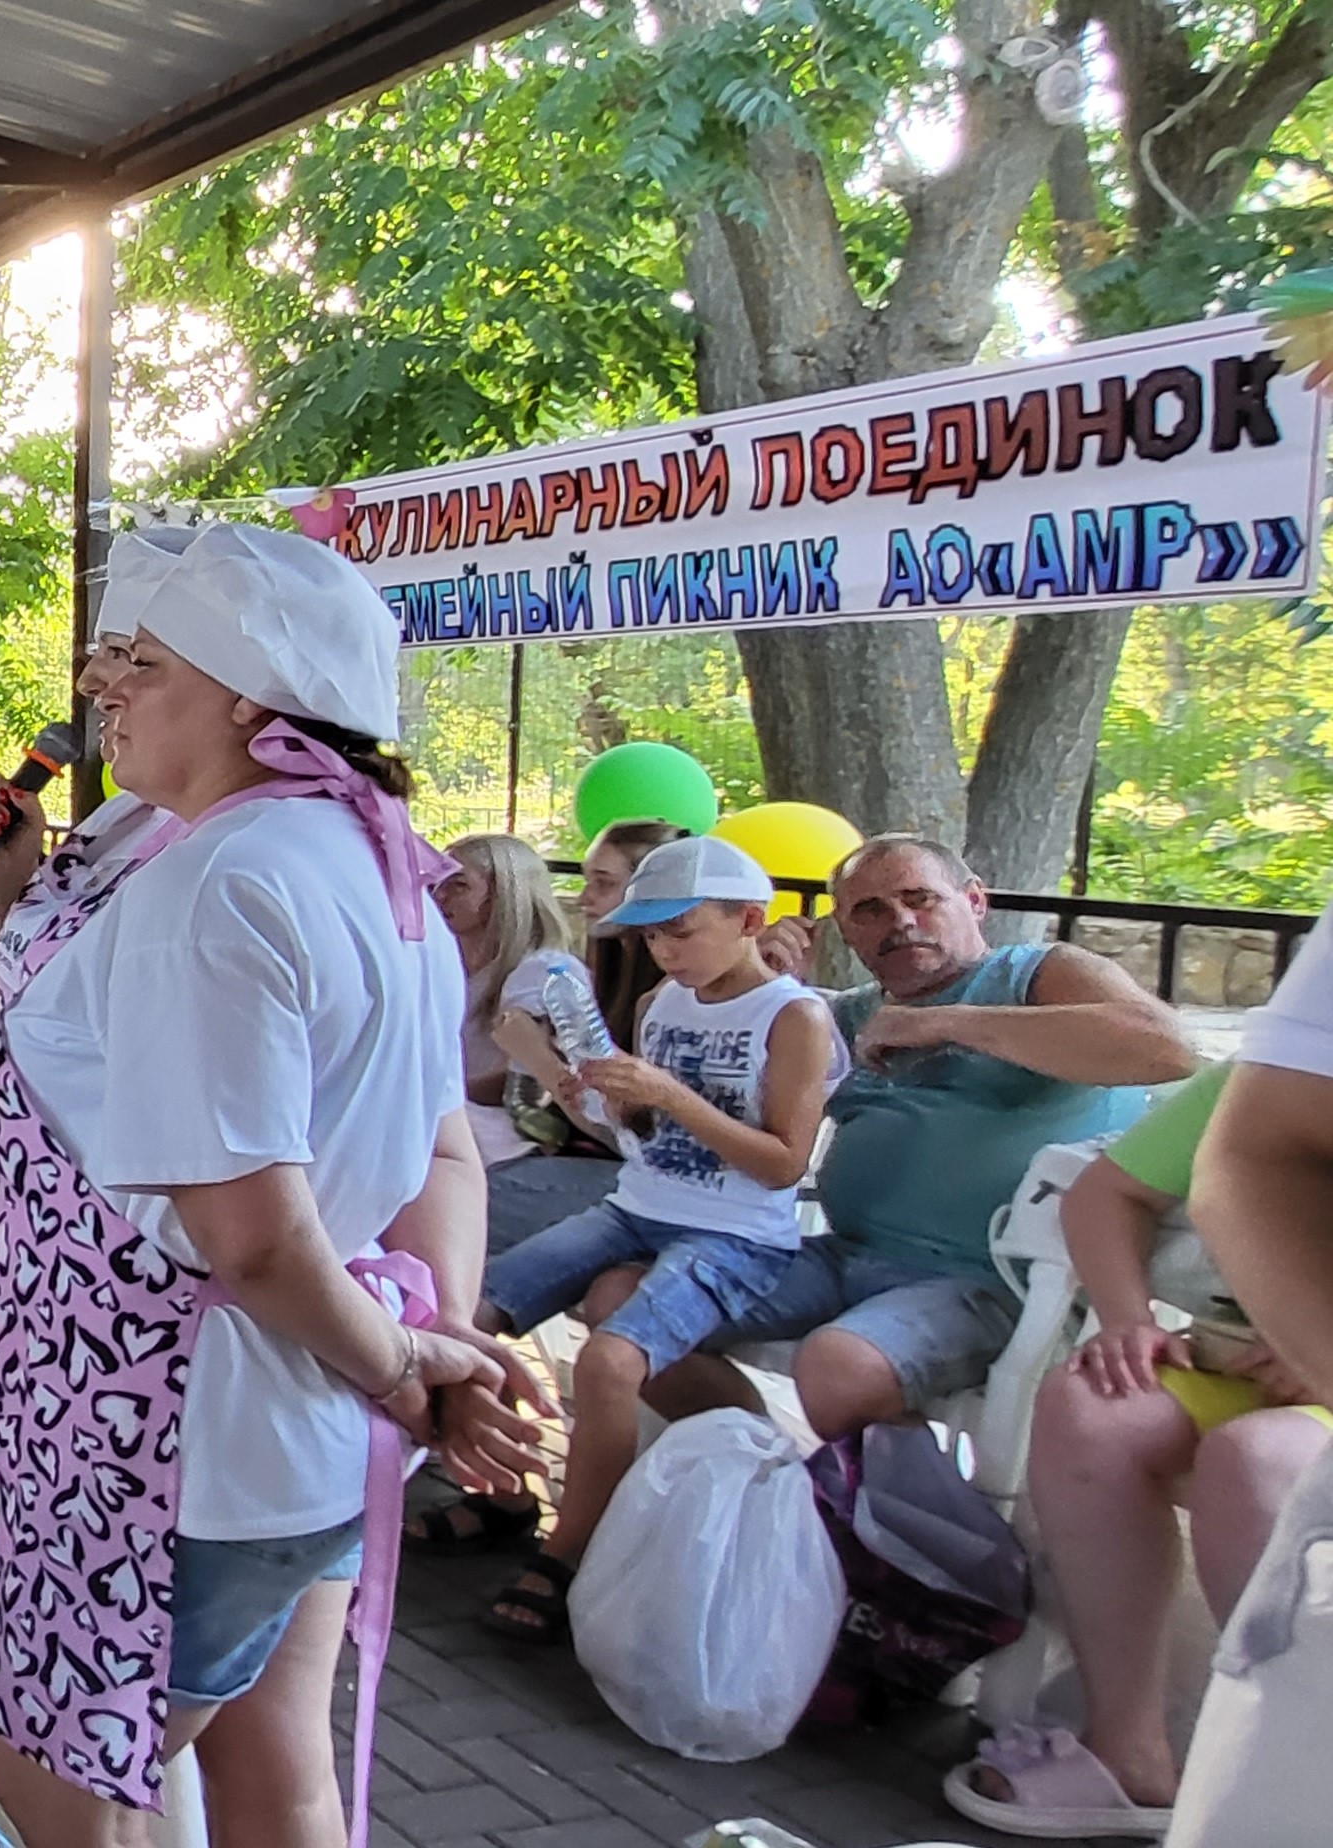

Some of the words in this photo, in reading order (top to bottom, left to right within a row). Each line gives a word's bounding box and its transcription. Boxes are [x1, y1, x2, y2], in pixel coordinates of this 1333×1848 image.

[334, 428, 730, 564] КУЛИНАРНЫЙ
[749, 350, 1283, 511] ПОЕДИНОК
[373, 551, 593, 645] ЕМЕЙНЫЙ
[607, 535, 841, 628] ПИКНИК
